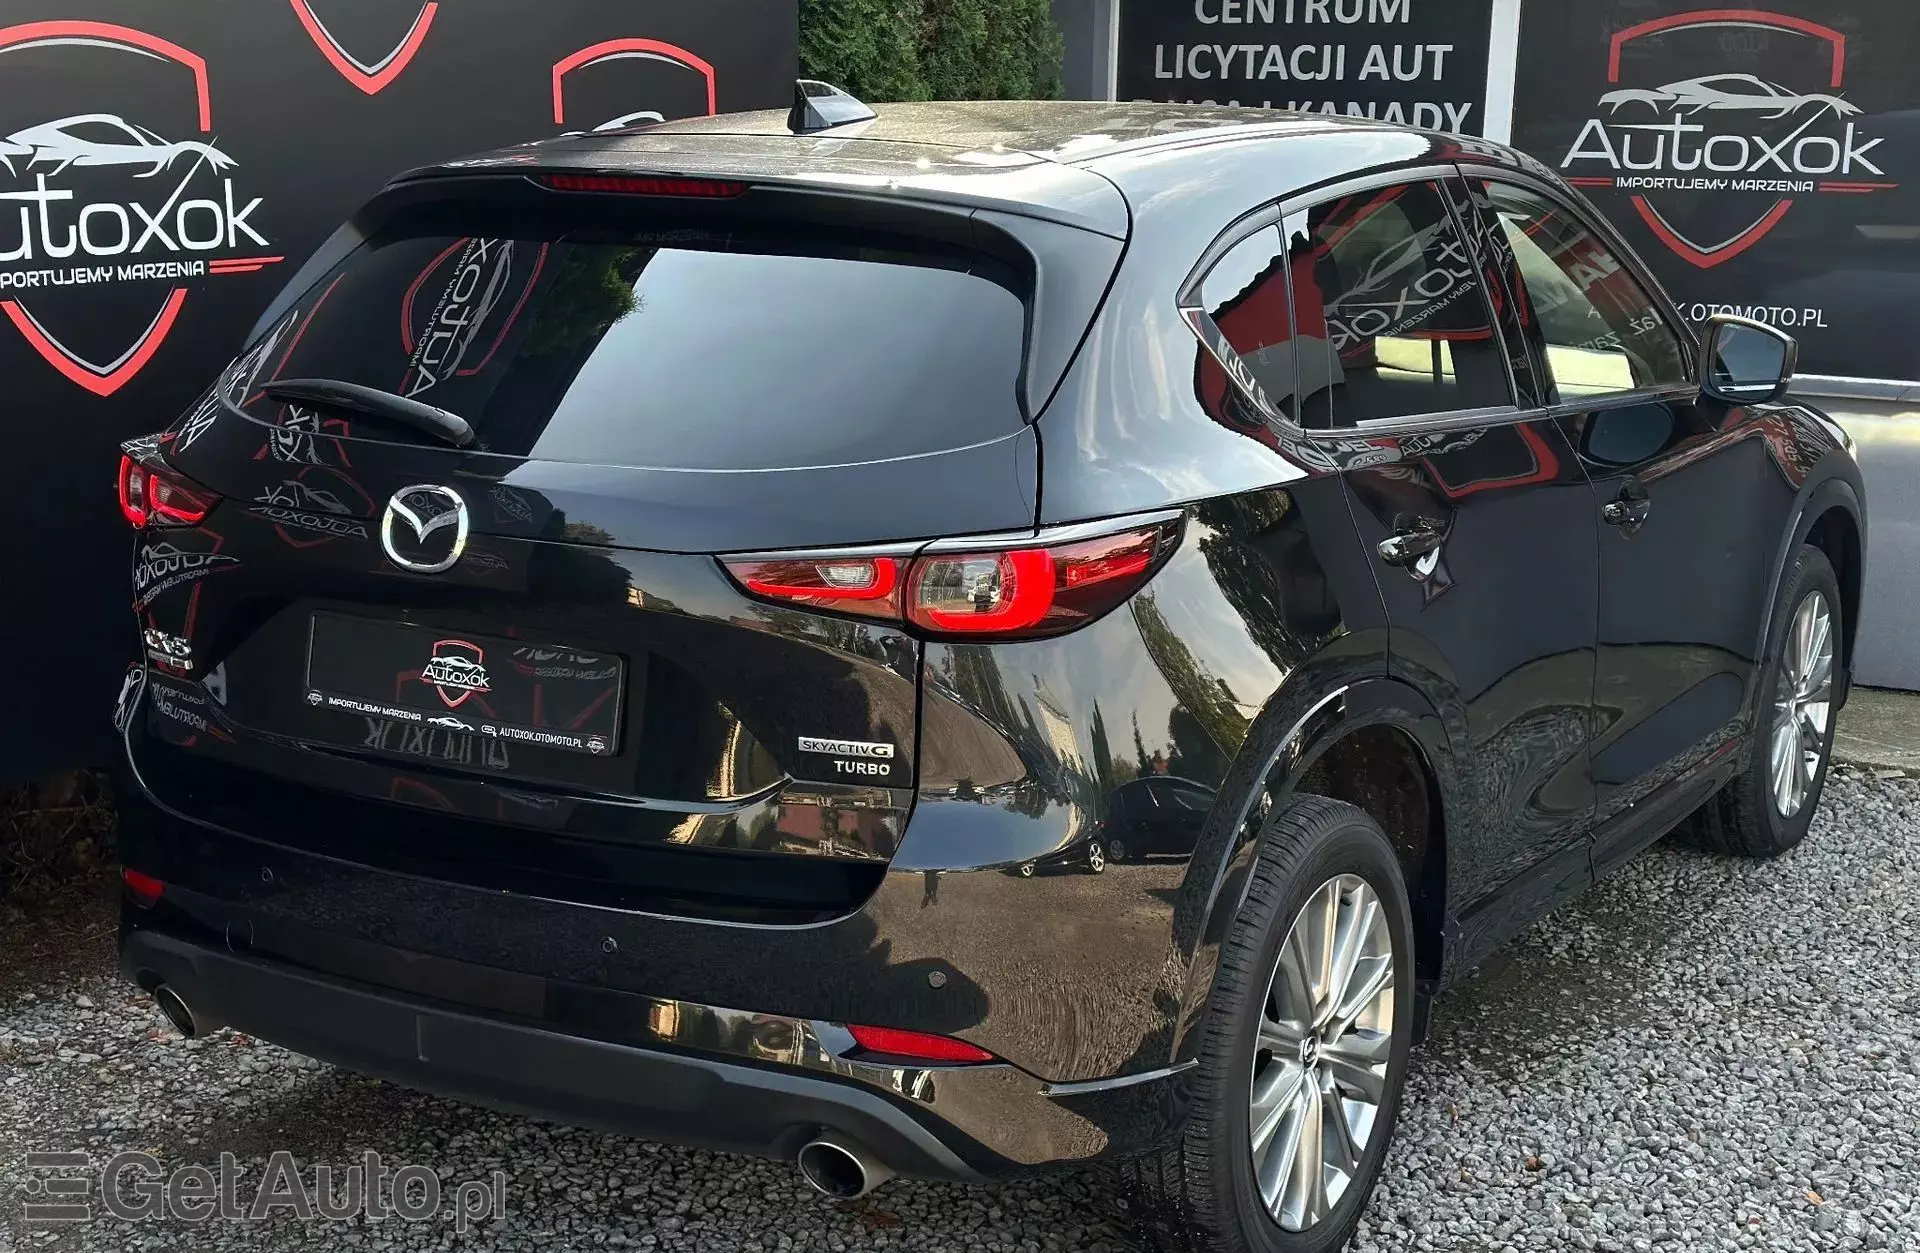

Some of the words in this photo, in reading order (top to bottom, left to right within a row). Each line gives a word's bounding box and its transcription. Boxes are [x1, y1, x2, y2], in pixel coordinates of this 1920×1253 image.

[1194, 0, 1411, 24] CENTRUM
[1154, 44, 1345, 81] LICYTACJI
[1358, 44, 1453, 81] AUT
[1560, 100, 1885, 176] Autoxok
[1616, 177, 1727, 191] IMPORTUJEMY
[1731, 180, 1814, 192] MARZENIA
[0, 165, 270, 262] utoxok
[0, 265, 114, 289] PORTUJEMY
[117, 260, 205, 281] MARZENIA
[421, 664, 490, 688] Autoxok
[328, 696, 381, 714] IMPORTUJEMY
[382, 708, 422, 721] MARZENIA
[499, 727, 583, 748] AUTOXOK.OTOMOTO.PL
[833, 760, 891, 776] TURBO
